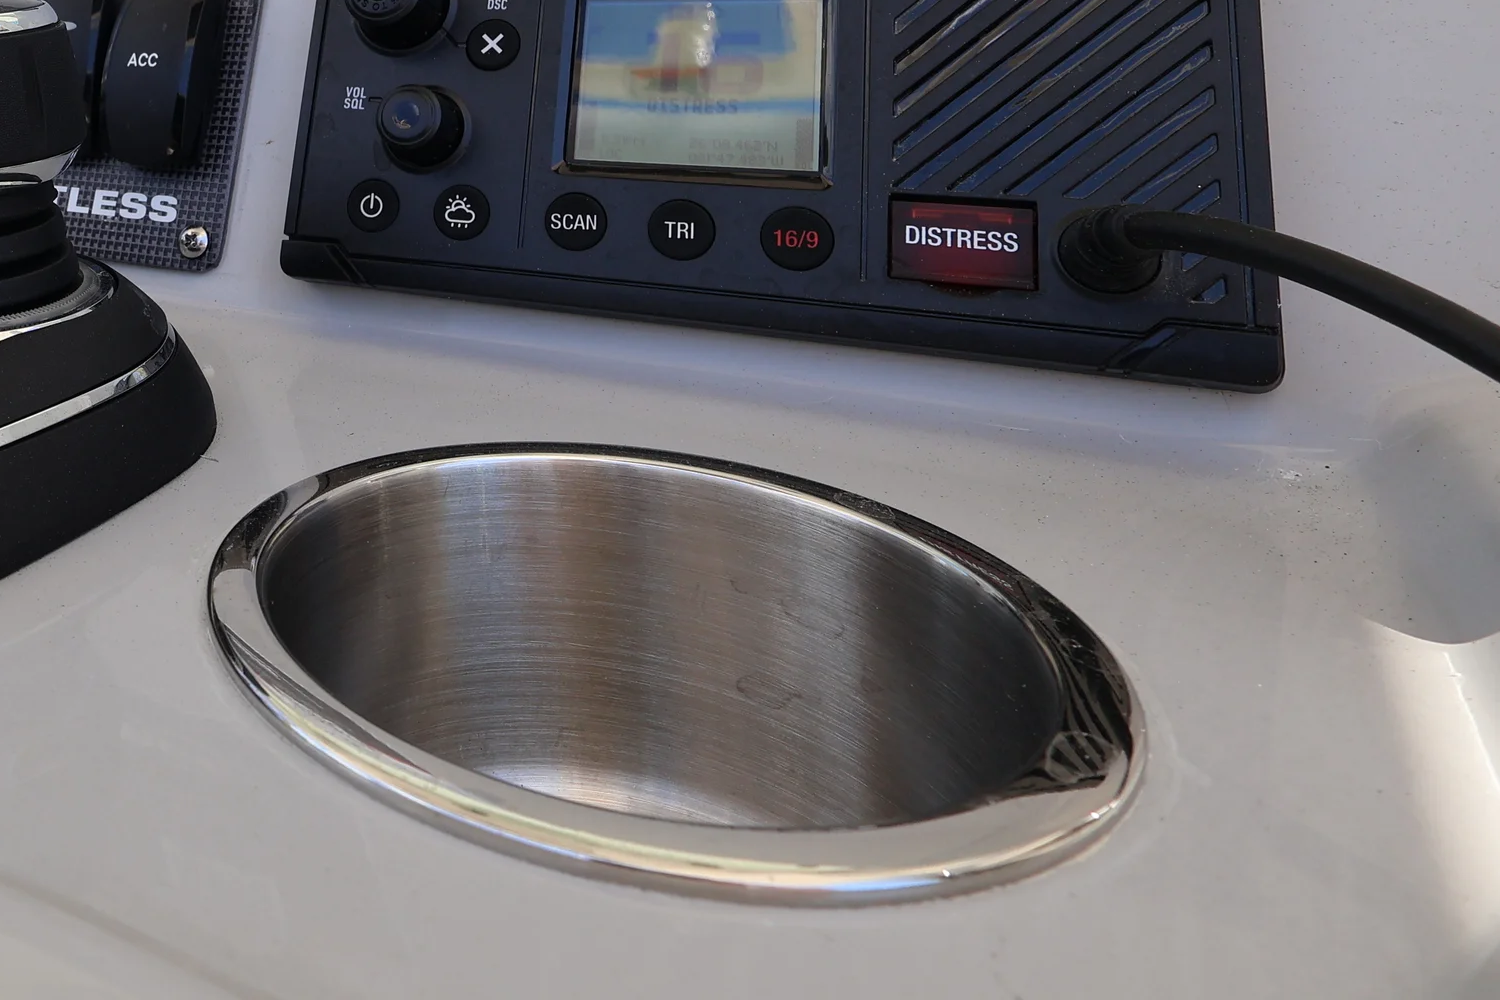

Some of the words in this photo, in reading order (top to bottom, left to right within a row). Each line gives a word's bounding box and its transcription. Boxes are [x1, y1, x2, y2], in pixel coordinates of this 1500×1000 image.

[127, 53, 159, 67] ACC
[346, 86, 367, 99] VOL
[343, 98, 365, 110] SQL
[550, 213, 598, 231] SCAN
[664, 221, 695, 240] TRI
[773, 229, 819, 249] 16/9
[905, 224, 1019, 253] DISTRESS
